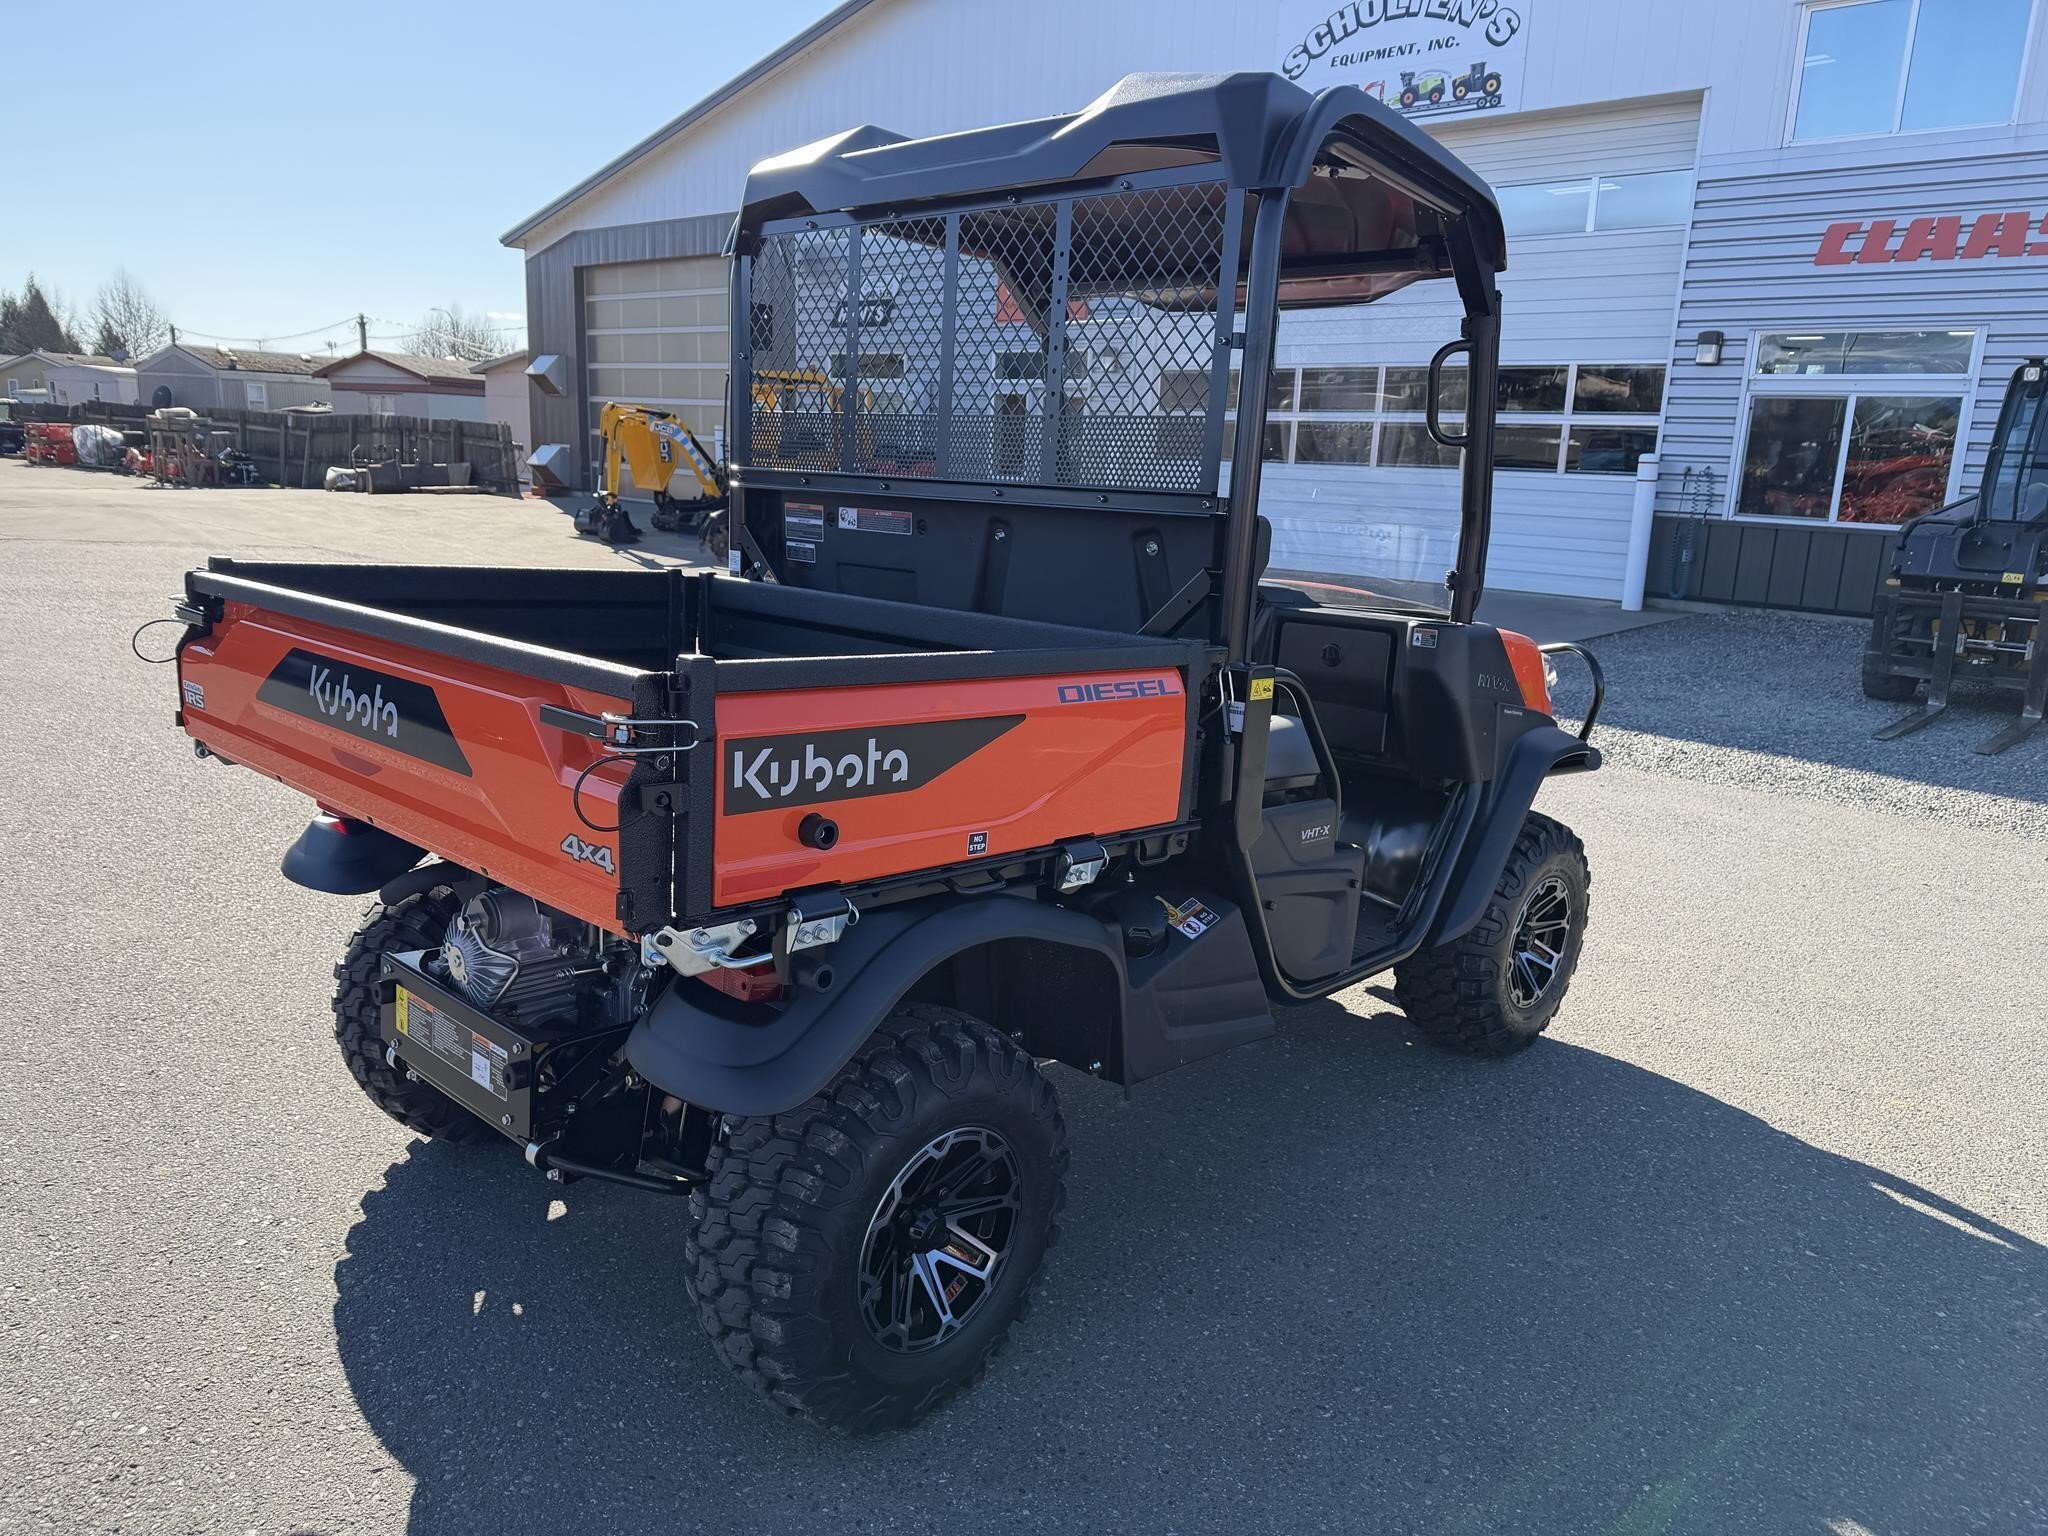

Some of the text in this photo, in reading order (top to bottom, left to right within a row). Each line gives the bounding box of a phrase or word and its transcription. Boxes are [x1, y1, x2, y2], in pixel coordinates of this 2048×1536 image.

[1330, 35, 1461, 68] EQUIPMENT, INC.
[654, 422, 674, 434] JCB
[184, 689, 205, 709] IRS
[309, 664, 398, 737] Kubota
[1057, 679, 1180, 704] DIESEL
[733, 738, 909, 799] Kubota
[560, 833, 616, 876] 4x4
[969, 843, 986, 851] STEP
